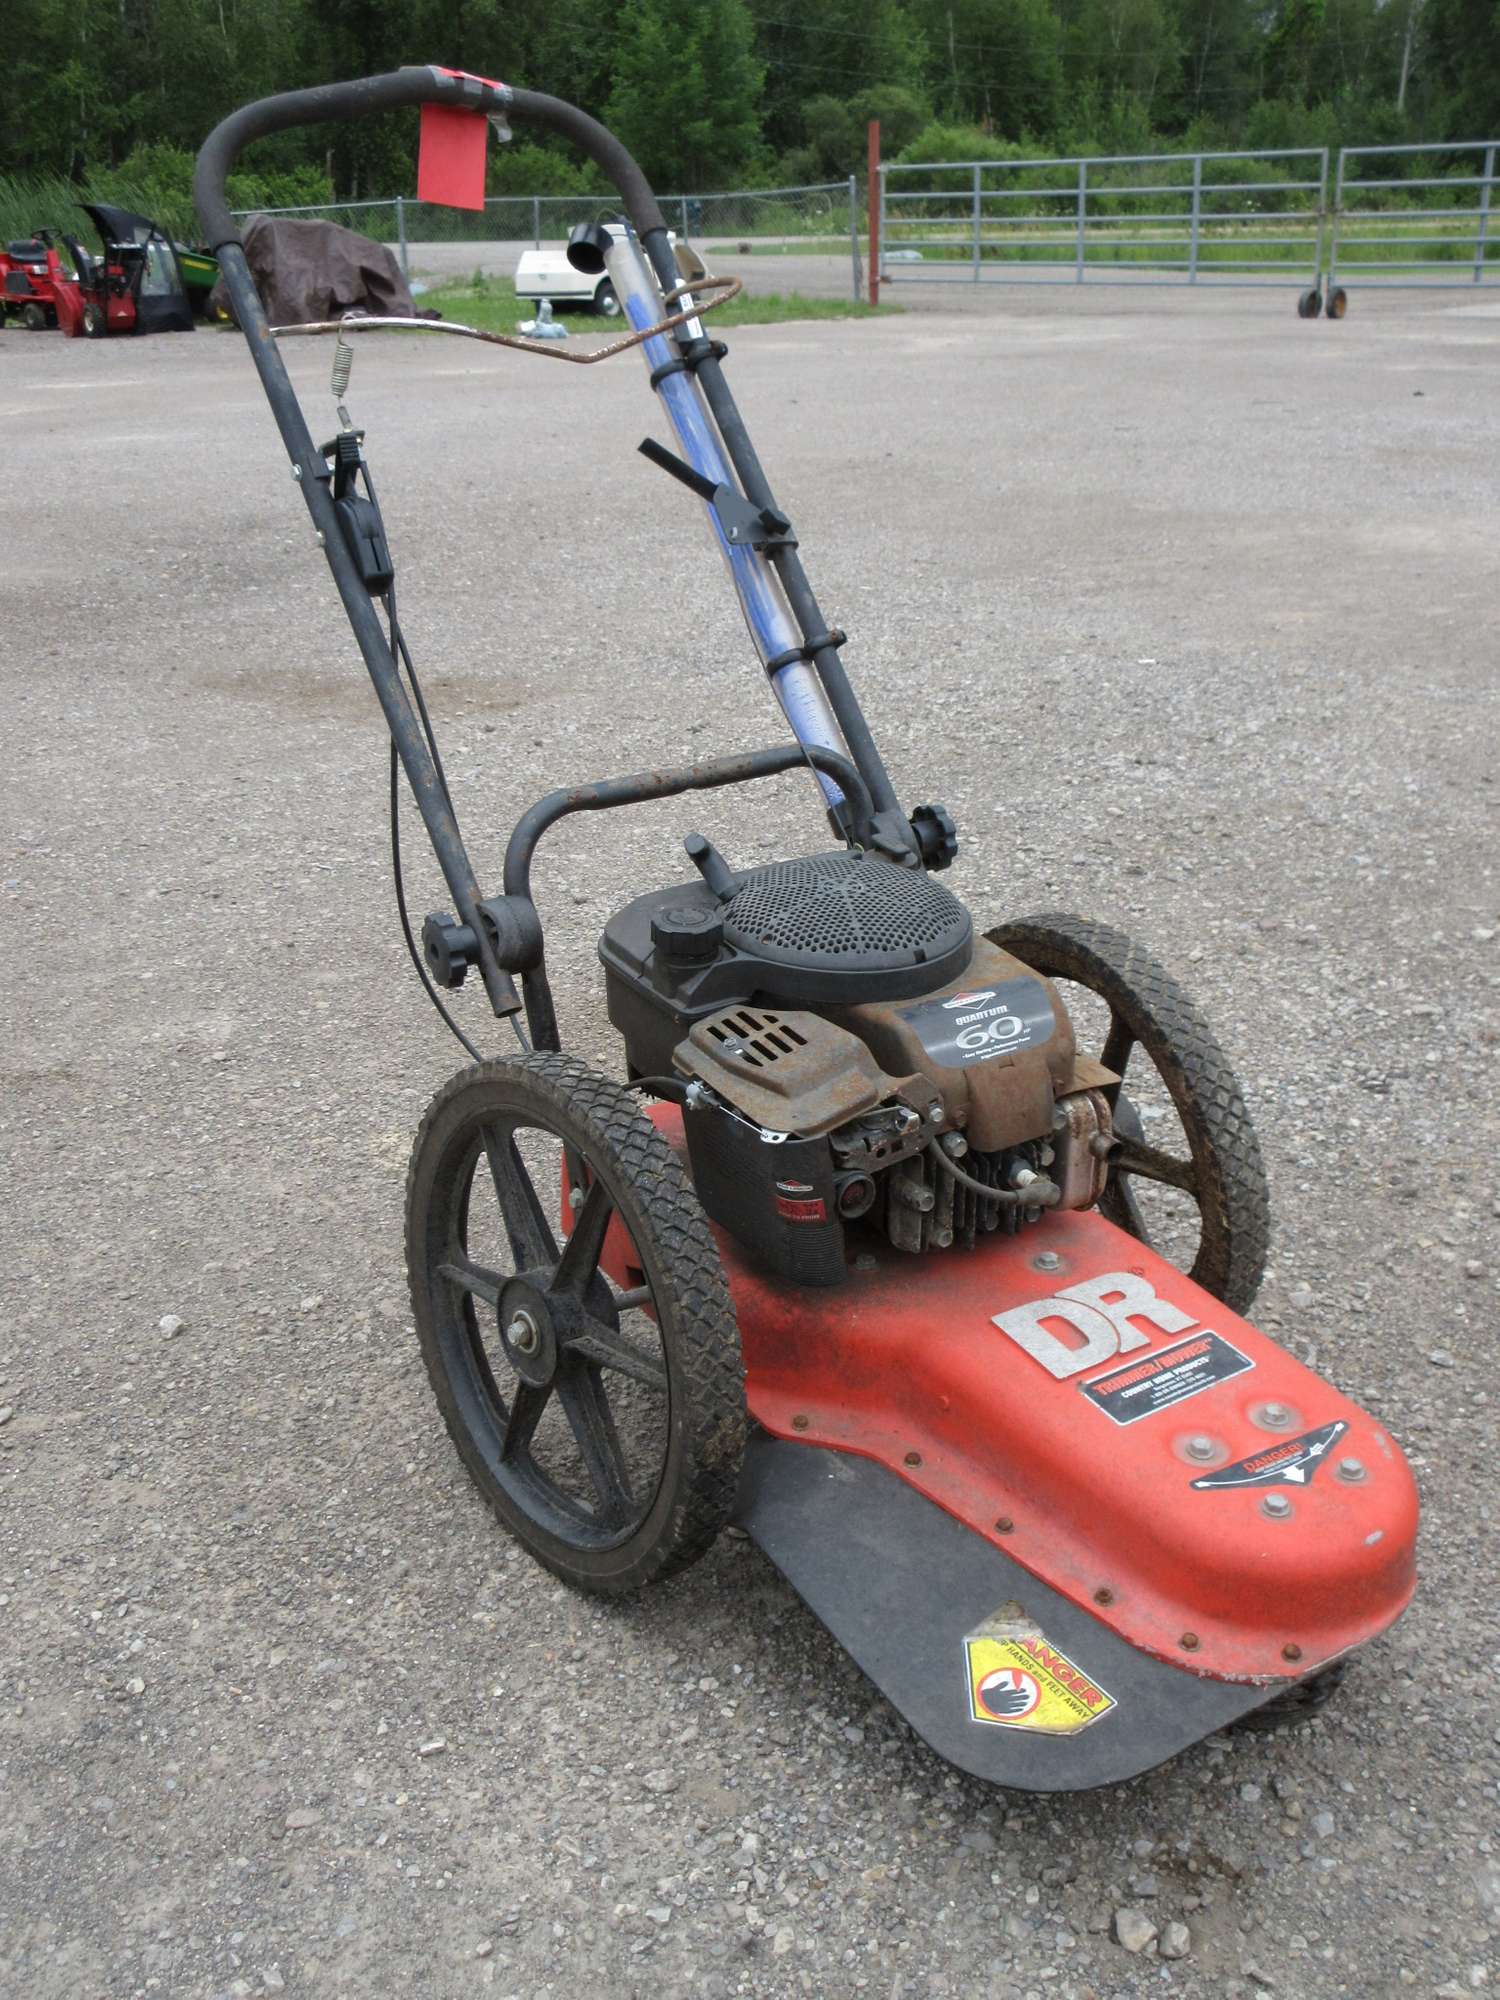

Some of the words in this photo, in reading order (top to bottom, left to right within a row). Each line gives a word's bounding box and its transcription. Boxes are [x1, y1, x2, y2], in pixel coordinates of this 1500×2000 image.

[955, 1005, 1008, 1026] QUANTUM
[955, 1016, 1023, 1049] 6.0
[991, 1272, 1199, 1379] DR
[1007, 1645, 1034, 1671] HANDS
[1046, 1679, 1066, 1698] FEET
[1064, 1695, 1091, 1719] AWAY
[1021, 1636, 1103, 1707] ANGER
